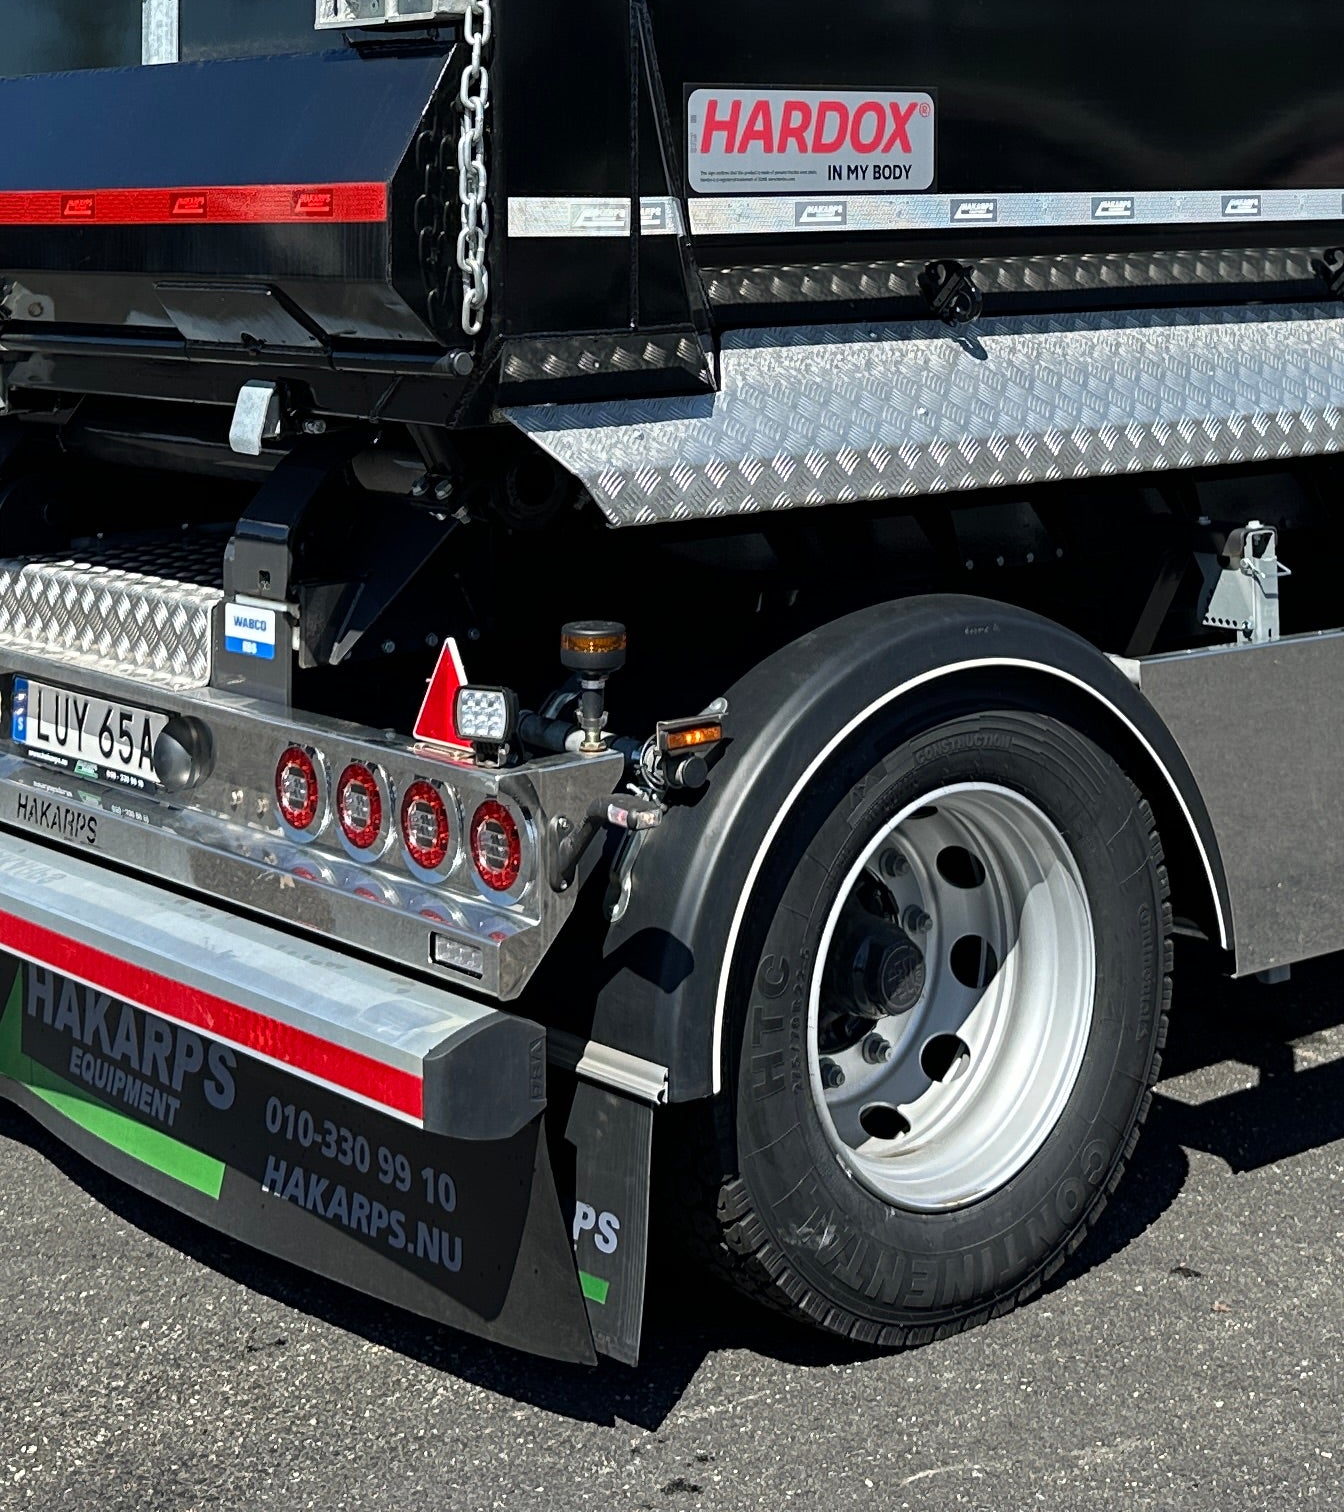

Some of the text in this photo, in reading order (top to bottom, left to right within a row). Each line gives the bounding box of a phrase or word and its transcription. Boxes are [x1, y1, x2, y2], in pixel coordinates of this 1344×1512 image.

[700, 99, 918, 154] HARDOX
[828, 165, 843, 181] IN
[847, 165, 868, 180] MY
[873, 164, 912, 180] BODY
[233, 615, 267, 632] WABCO
[36, 689, 156, 772] LUY 65A
[17, 792, 98, 844] HAKARPS
[26, 964, 237, 1111] HAKARPS
[751, 953, 791, 1102] HTC
[69, 1046, 181, 1126] EQUIPMENT
[265, 1096, 457, 1213] 010-330 99 10
[262, 1155, 464, 1273] HAKARPS.NU
